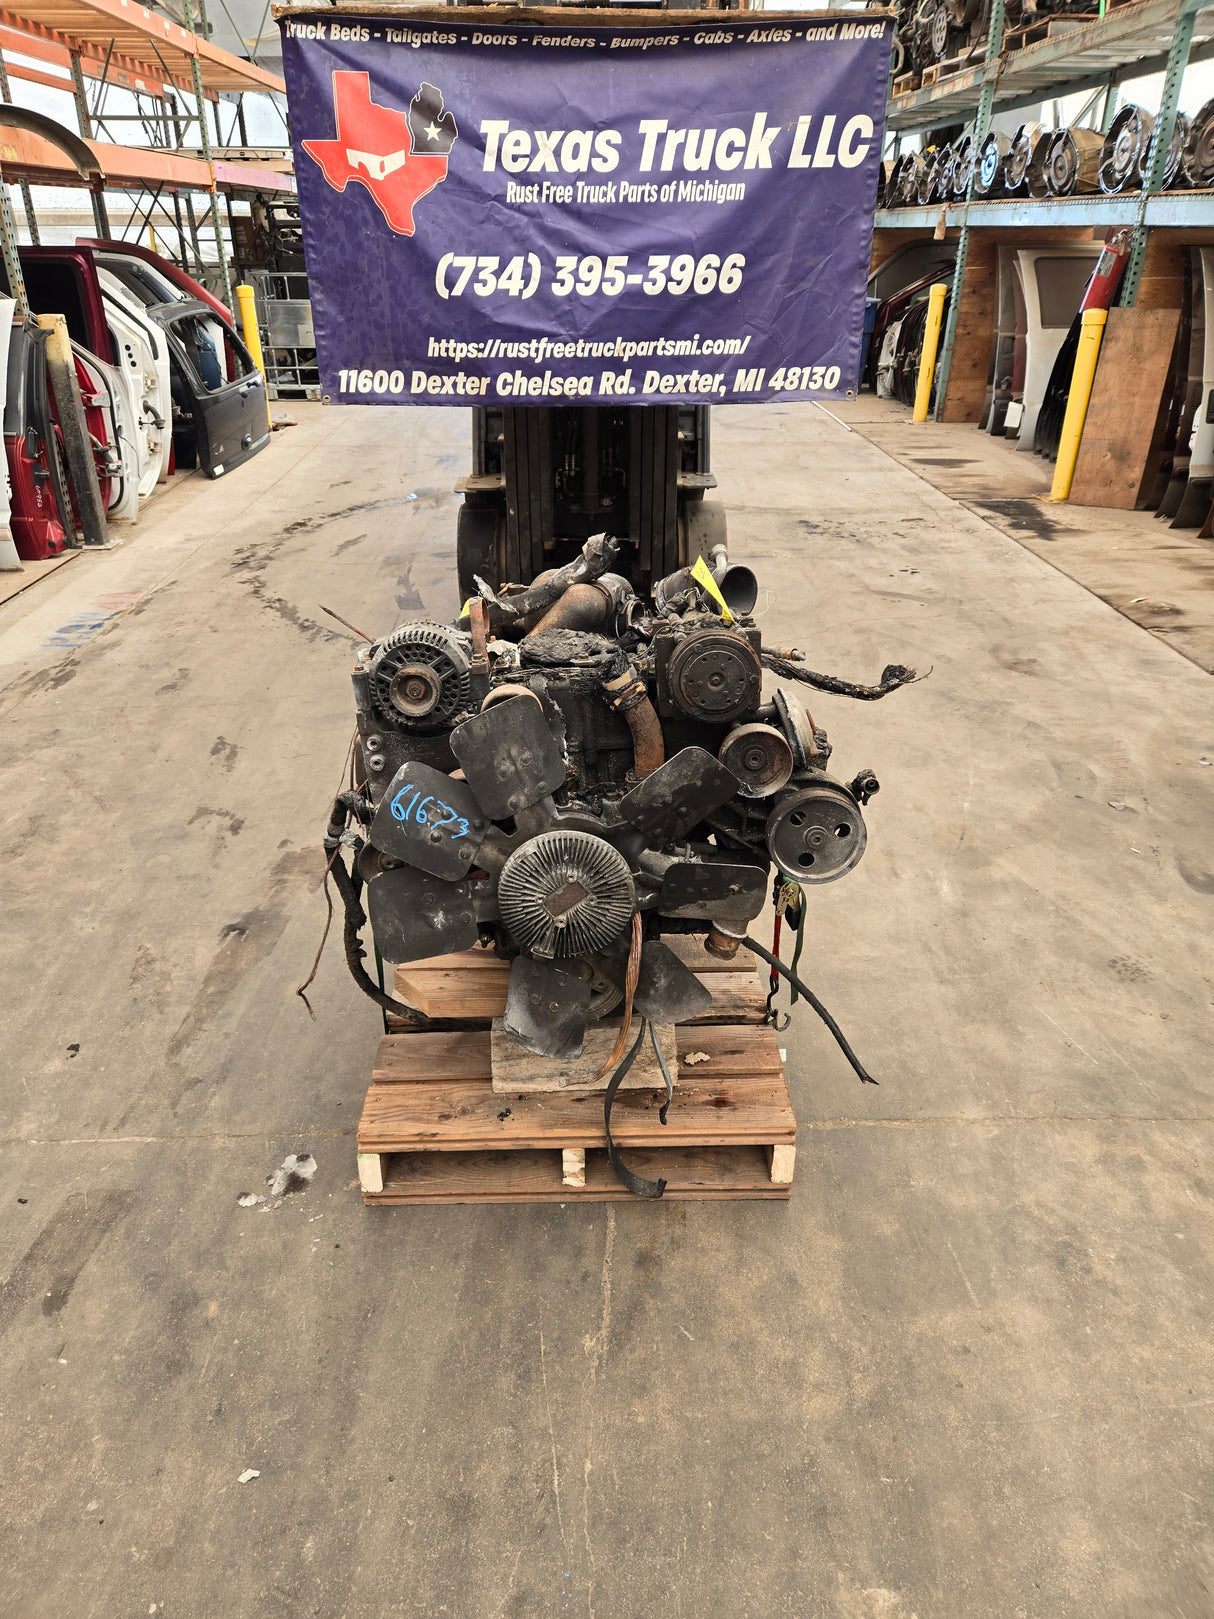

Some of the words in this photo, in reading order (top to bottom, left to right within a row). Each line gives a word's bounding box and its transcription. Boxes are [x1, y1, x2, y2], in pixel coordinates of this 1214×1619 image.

[285, 20, 326, 39] Truck
[330, 24, 369, 42] Beds
[386, 29, 456, 48] Tailgates
[472, 33, 517, 45] Doors
[533, 36, 595, 47] Fenders
[610, 36, 679, 49] Bumpers
[694, 31, 733, 44] Cabs
[746, 29, 792, 42] Axles
[806, 24, 838, 41] and
[839, 21, 886, 42] More!
[480, 120, 621, 172] Texas
[639, 112, 781, 171] Truck
[787, 114, 874, 168] LLC
[507, 182, 539, 203] Rust
[542, 182, 573, 203] Free
[577, 182, 617, 203] Truck
[619, 181, 658, 202] Parts
[661, 181, 679, 202] of
[678, 180, 745, 204] Michigan
[436, 253, 540, 299] (734)
[551, 254, 745, 296] 395-3966
[428, 334, 751, 363] https://rustfreetruckpartsmi.com/
[339, 370, 404, 394] 11600
[410, 371, 490, 395] Dexter
[496, 370, 593, 398] Chelsea
[599, 369, 636, 395] Rd.
[642, 370, 726, 397] Dexter,
[733, 368, 766, 392] MI
[768, 366, 840, 393] 48130
[391, 785, 469, 838] 61673
